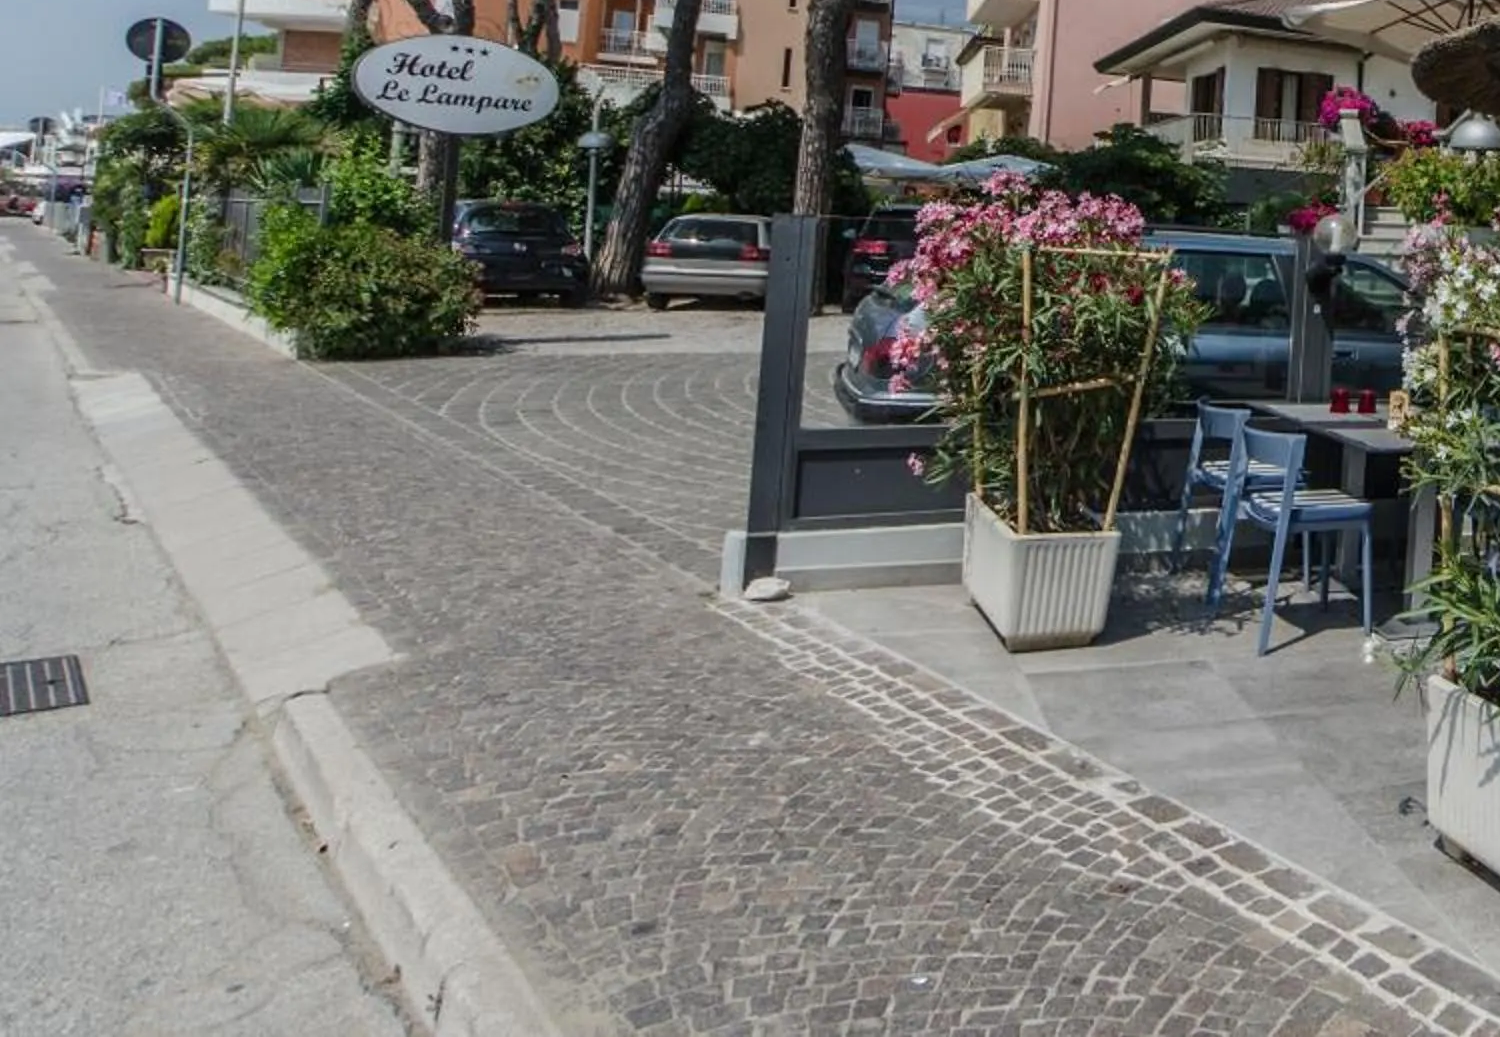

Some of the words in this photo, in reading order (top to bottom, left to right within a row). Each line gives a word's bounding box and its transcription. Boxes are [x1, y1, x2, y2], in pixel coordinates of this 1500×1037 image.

[386, 52, 475, 81] Hotel
[376, 80, 410, 102] Le
[416, 83, 533, 114] Lampare
